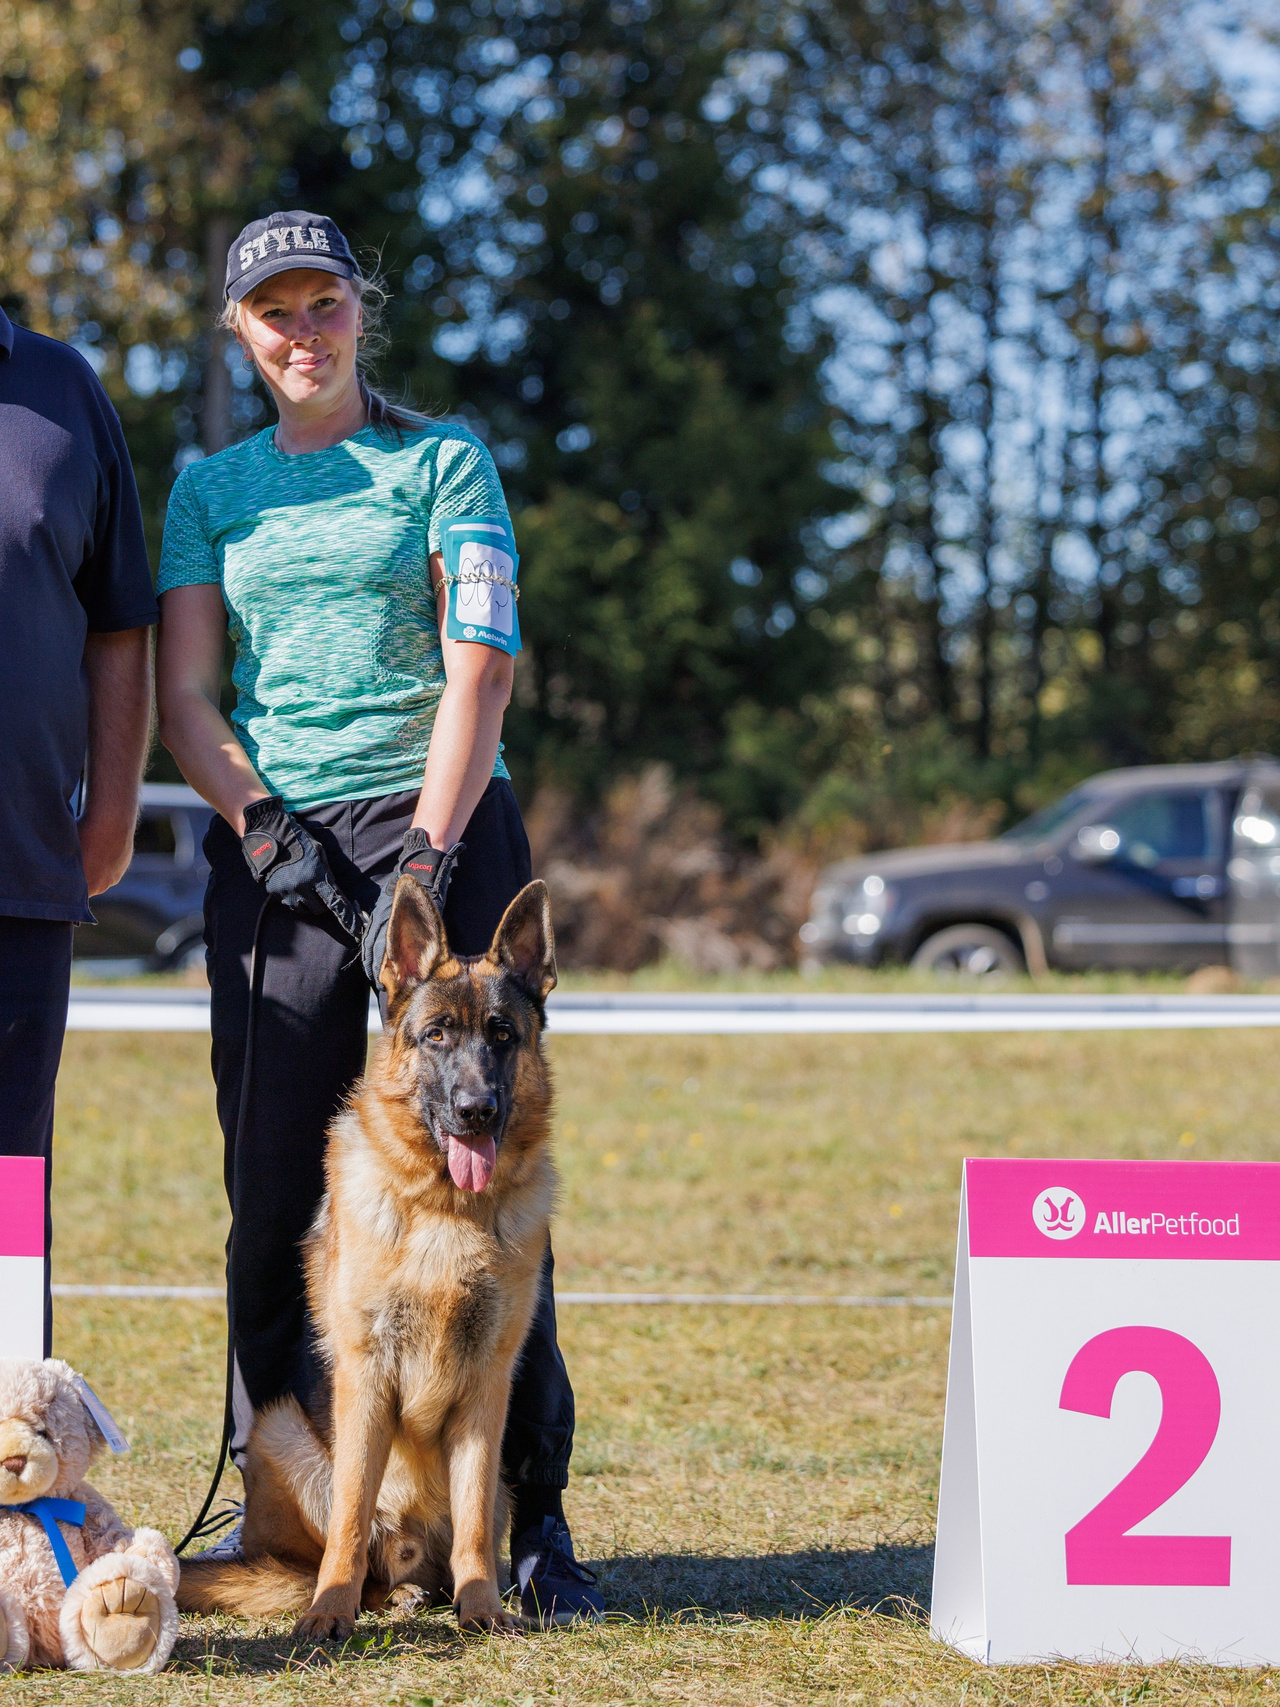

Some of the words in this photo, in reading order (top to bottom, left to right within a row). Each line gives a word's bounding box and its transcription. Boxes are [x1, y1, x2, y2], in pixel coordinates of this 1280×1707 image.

[239, 226, 331, 271] STYLE
[1093, 1211, 1240, 1236] AllerPetfood
[1058, 1325, 1232, 1587] 2
